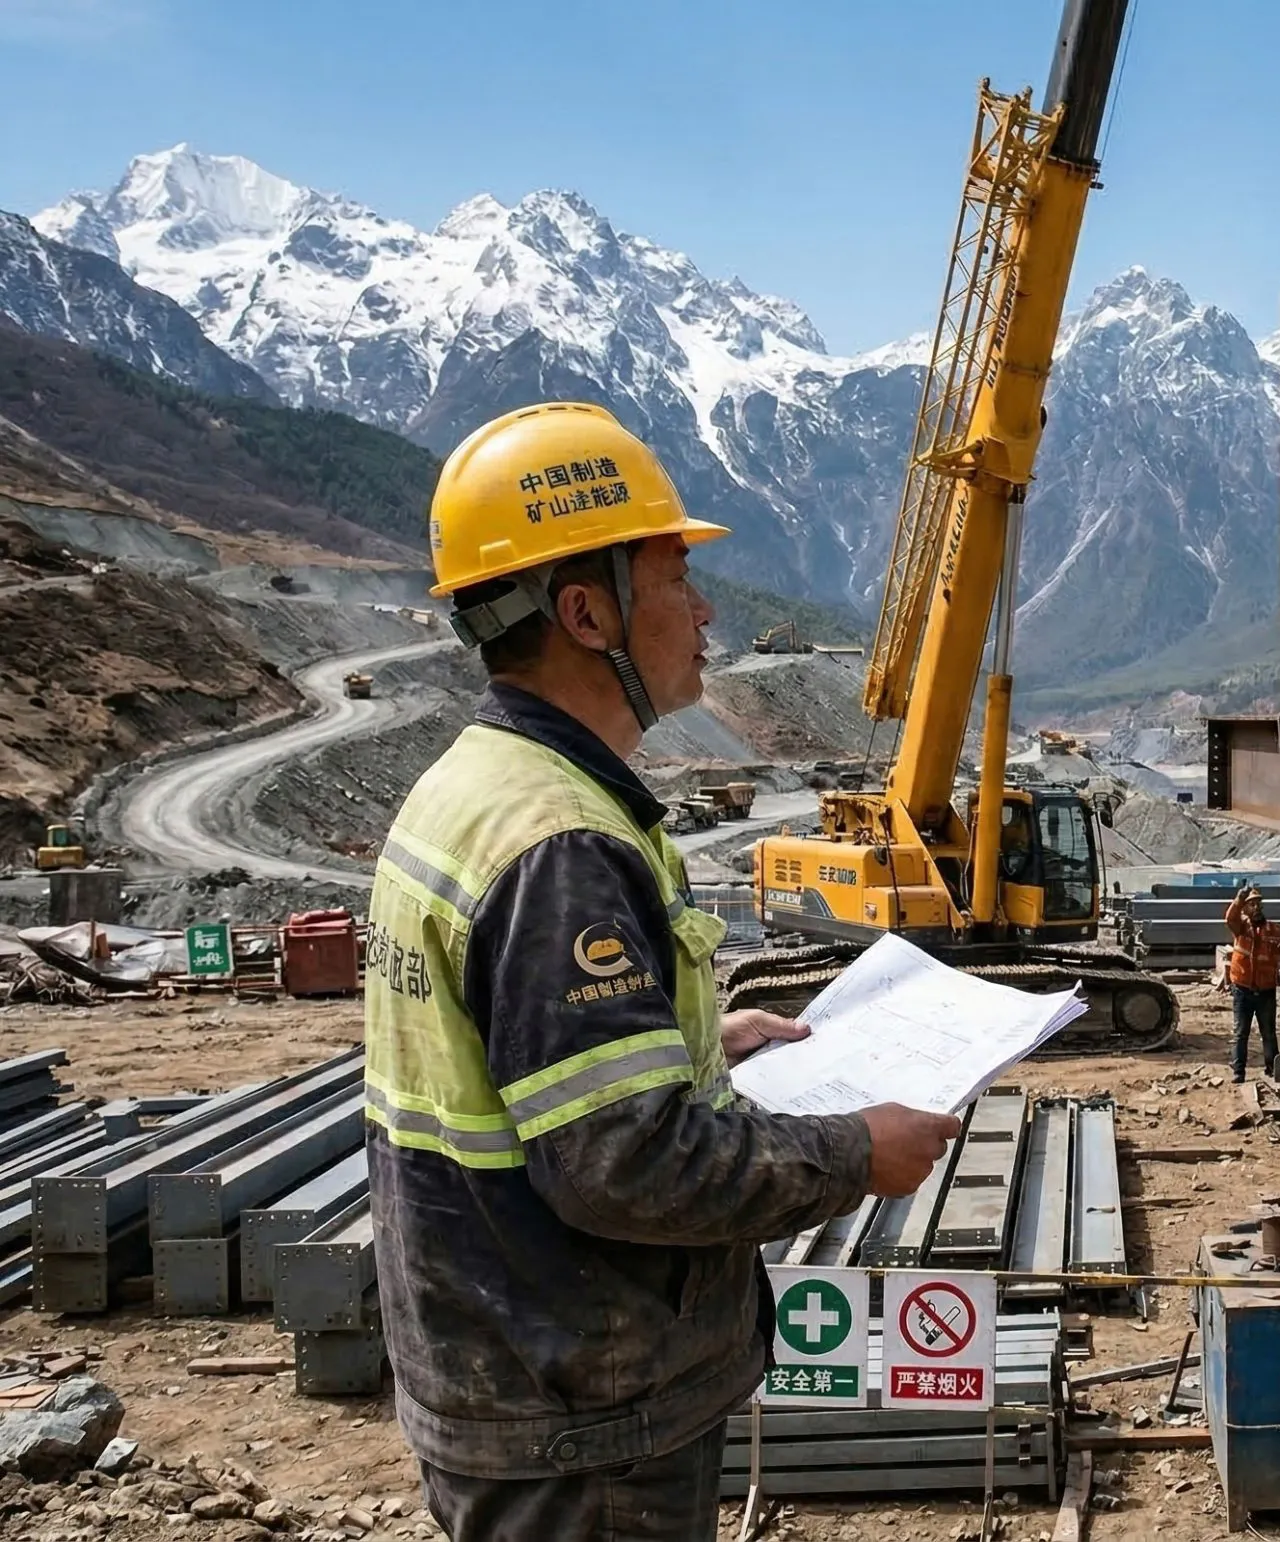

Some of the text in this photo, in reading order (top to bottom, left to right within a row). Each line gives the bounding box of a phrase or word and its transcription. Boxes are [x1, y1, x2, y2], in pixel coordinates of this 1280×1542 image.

[519, 456, 620, 495] 中国制造
[771, 1368, 854, 1393] 安全第一
[895, 1371, 978, 1397] 严禁烟火
